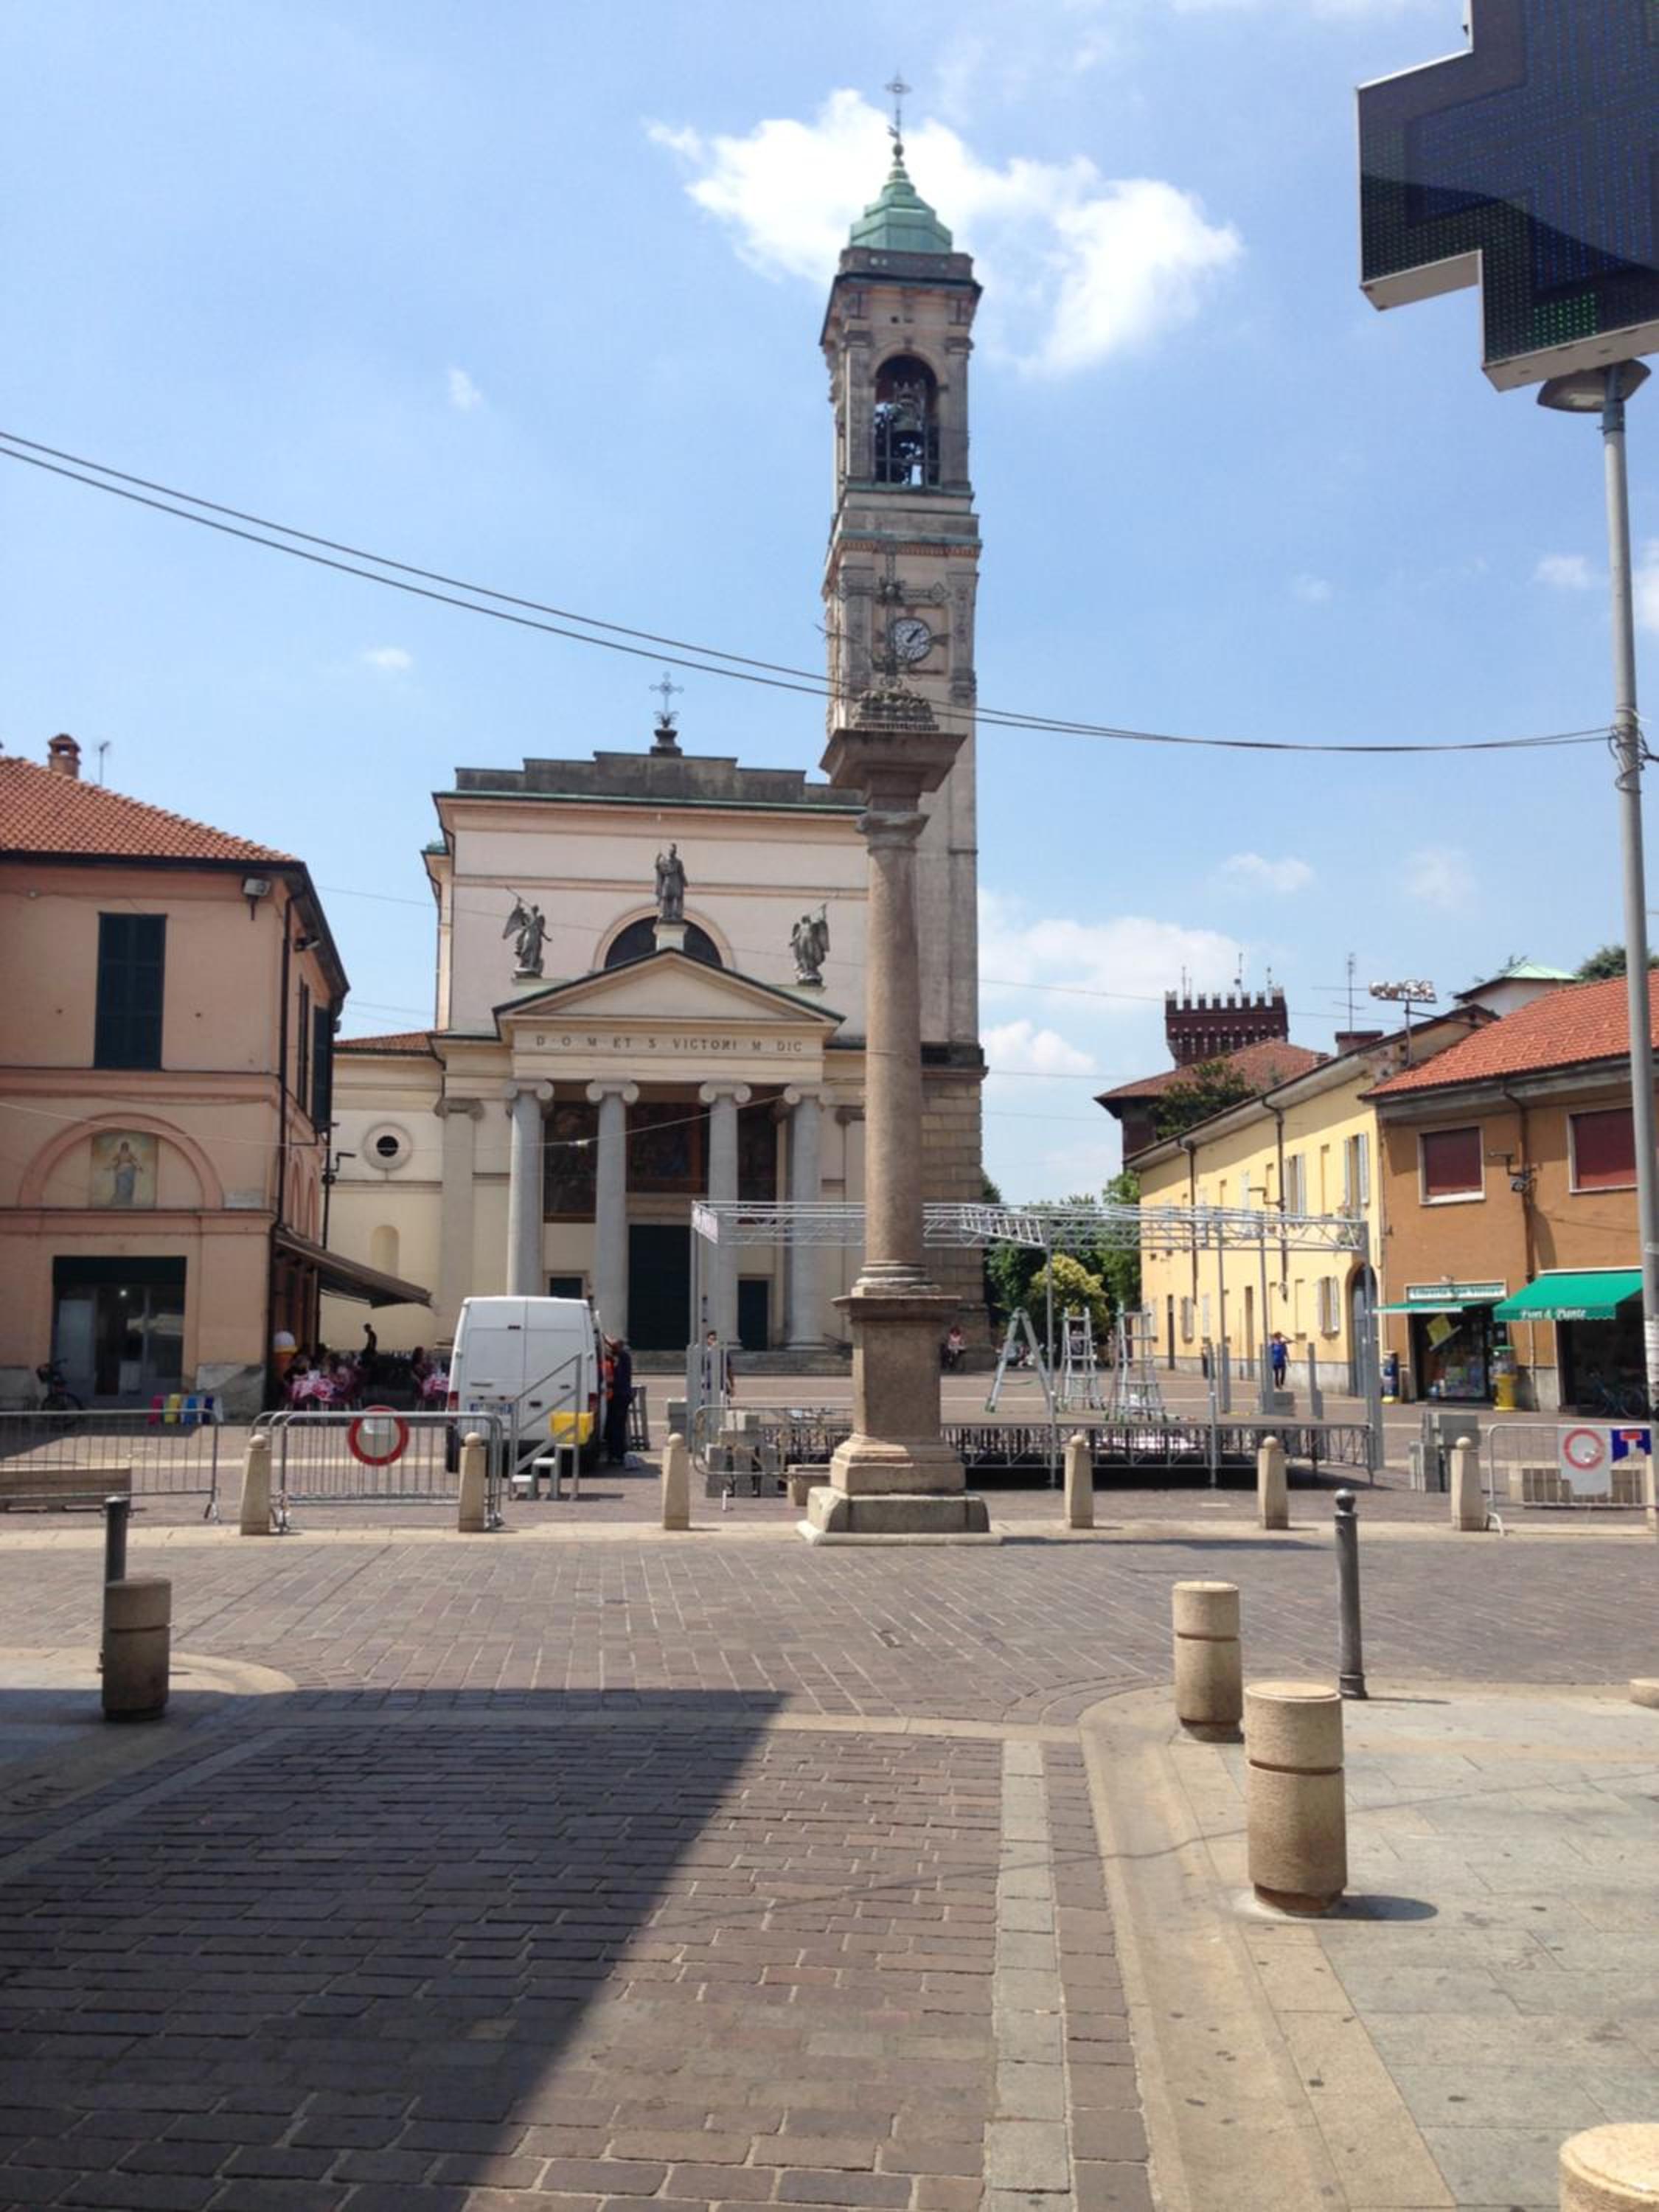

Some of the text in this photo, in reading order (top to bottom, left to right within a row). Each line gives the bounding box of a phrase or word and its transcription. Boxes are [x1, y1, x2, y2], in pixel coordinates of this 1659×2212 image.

[587, 1037, 597, 1047] M
[613, 1037, 631, 1049] ET
[648, 1037, 657, 1049] S
[672, 1037, 737, 1051] VICTORI
[776, 1040, 803, 1052] DIC
